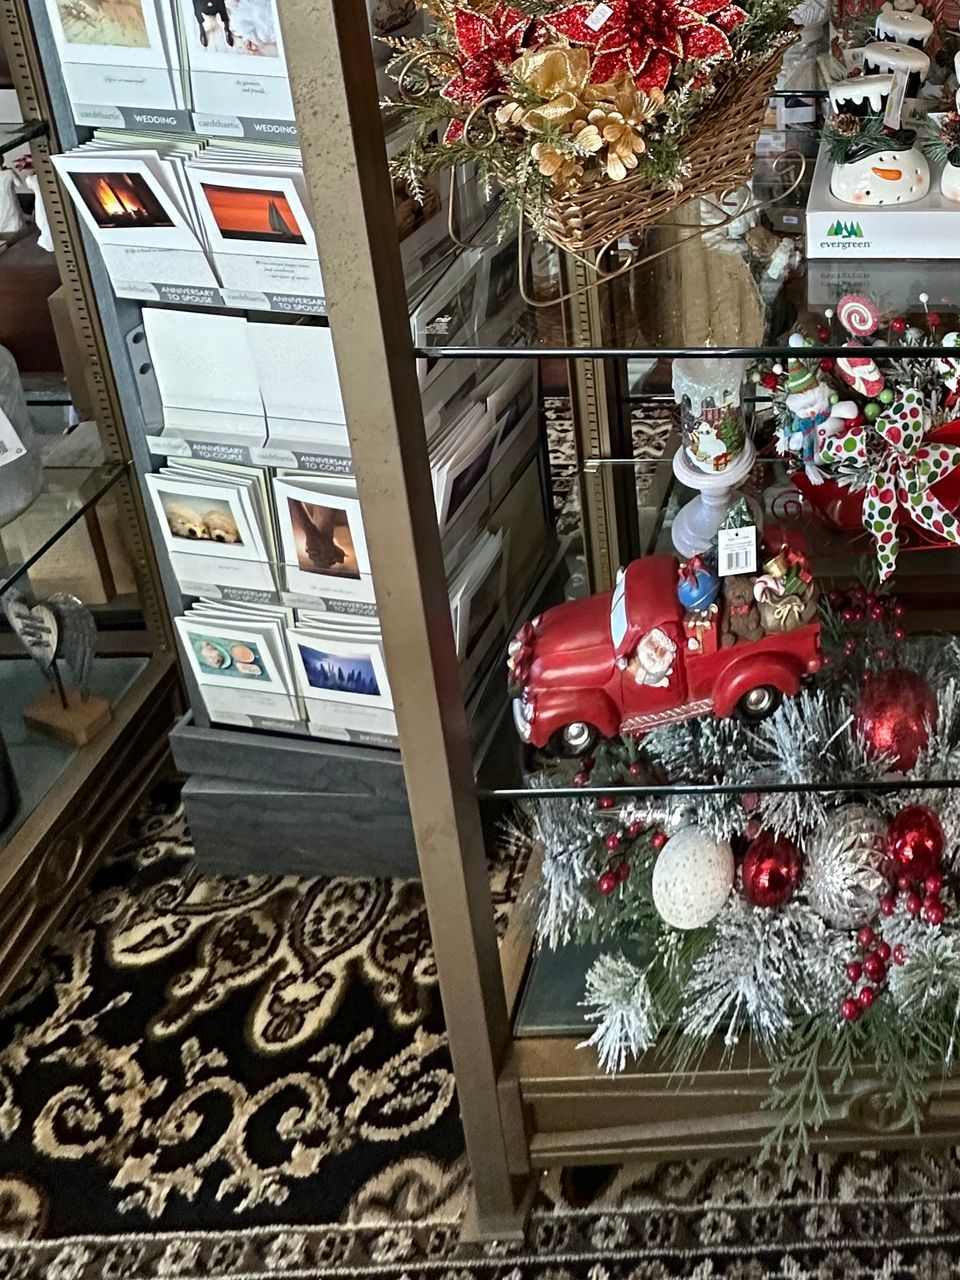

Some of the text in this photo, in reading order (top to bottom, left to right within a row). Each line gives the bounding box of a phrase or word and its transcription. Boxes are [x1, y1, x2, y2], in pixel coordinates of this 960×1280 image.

[134, 114, 178, 126] WEDDING
[199, 119, 242, 131] cardthartic
[253, 123, 297, 135] WEDDING
[820, 240, 871, 250] evergreen
[161, 286, 214, 298] ANNIVERSARY
[168, 293, 213, 304] TO SPOUSE
[272, 294, 326, 307] ANNIVERSARY
[278, 302, 325, 313] TO SPOUSE
[193, 444, 243, 455] ANNIVERSARY
[212, 452, 243, 462] COUPLE
[300, 455, 352, 467] ANNIVERSARY
[320, 463, 350, 473] COUPLE
